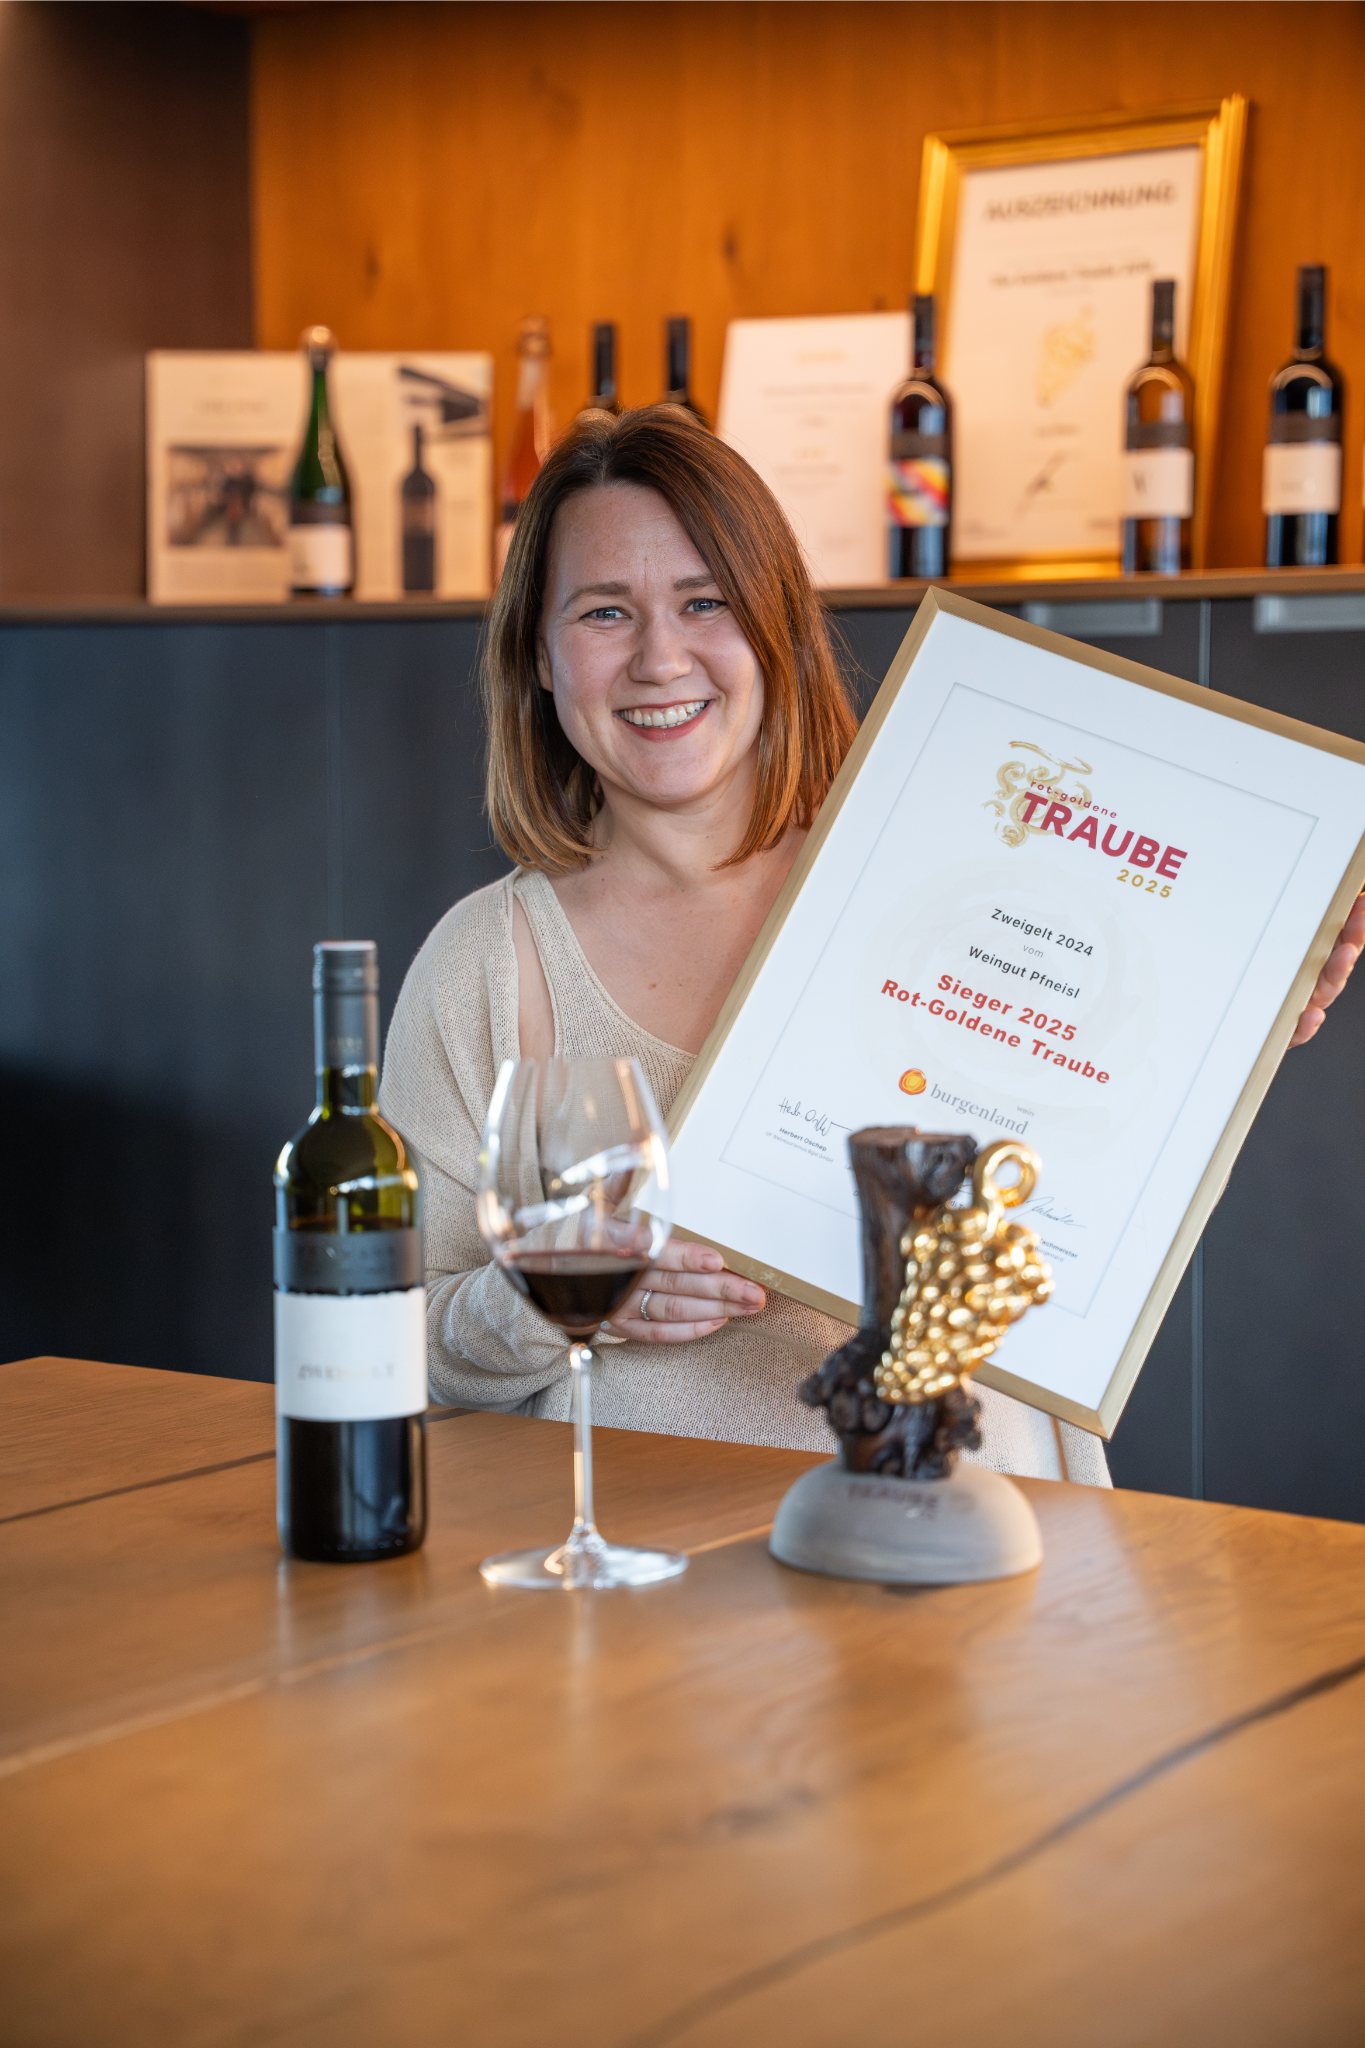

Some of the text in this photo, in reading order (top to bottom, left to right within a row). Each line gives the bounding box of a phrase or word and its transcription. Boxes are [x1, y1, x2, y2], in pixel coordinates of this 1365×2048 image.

[1030, 781, 1118, 819] rot-goldene
[1021, 791, 1189, 881] TRAUBE
[1116, 869, 1173, 898] 2025
[991, 908, 1094, 957] Zweigelt 2024
[1022, 945, 1045, 959] vom
[968, 945, 1081, 999] Weingut Pfneisl
[880, 979, 1111, 1084] Rot-Goldene Traube
[937, 974, 1077, 1042] Sieger 2025
[930, 1083, 1029, 1136] burgenland
[1016, 1104, 1036, 1118] wein
[778, 1127, 804, 1142] Herbert
